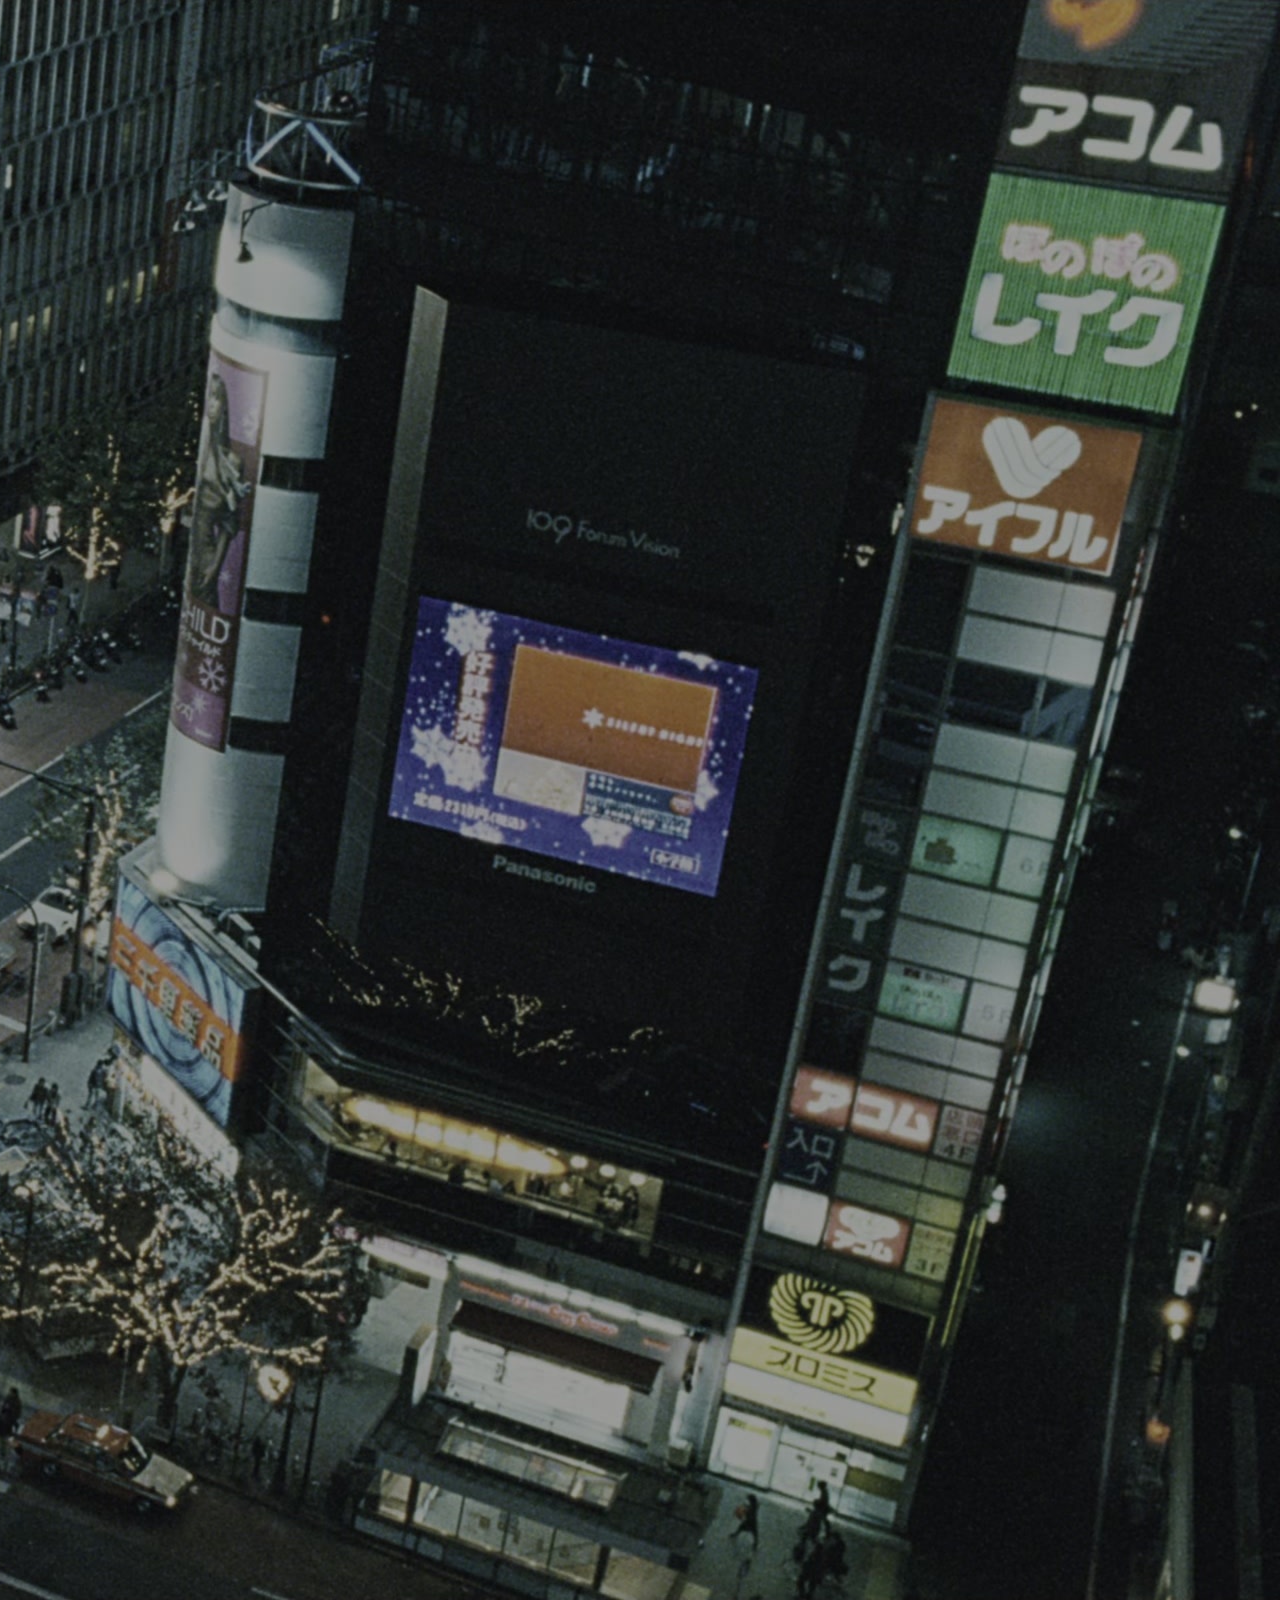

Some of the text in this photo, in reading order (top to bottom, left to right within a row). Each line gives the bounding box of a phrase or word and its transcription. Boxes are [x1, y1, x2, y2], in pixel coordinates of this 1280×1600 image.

[1009, 85, 1224, 171] アコム
[971, 273, 1184, 367] レイク
[525, 508, 681, 559] 109 Forum Vision
[916, 485, 1108, 564] アイフル
[492, 854, 598, 895] Panasonic
[827, 862, 887, 992] レイク
[786, 1126, 836, 1160] 入口
[803, 1077, 934, 1144] アコム
[766, 1345, 876, 1398] プロミス
